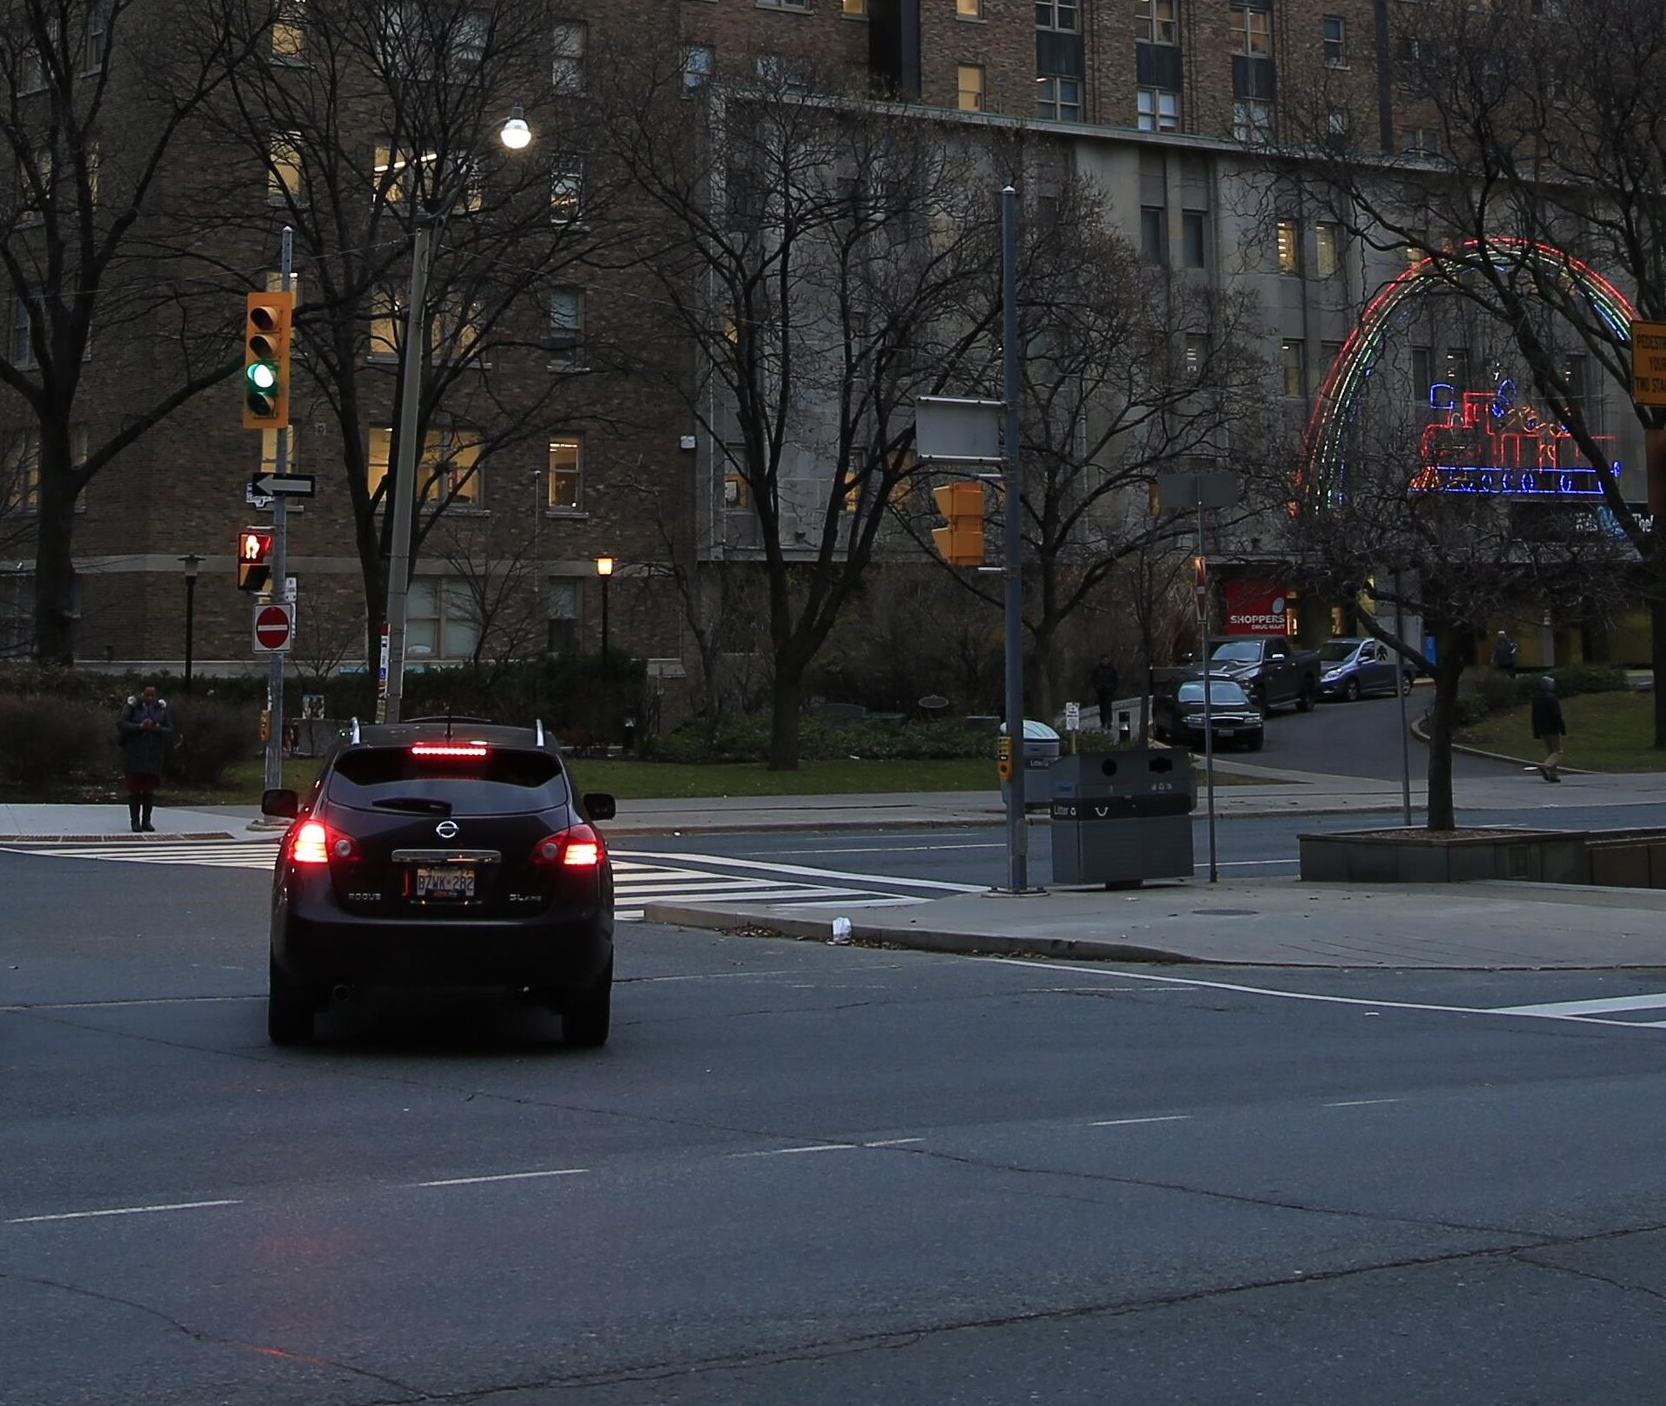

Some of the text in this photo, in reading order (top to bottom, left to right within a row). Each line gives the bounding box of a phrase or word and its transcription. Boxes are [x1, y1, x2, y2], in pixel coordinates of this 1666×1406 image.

[1648, 356, 1666, 372] YOUR
[1635, 377, 1649, 392] TWO
[1230, 615, 1285, 624] SHOPPERS
